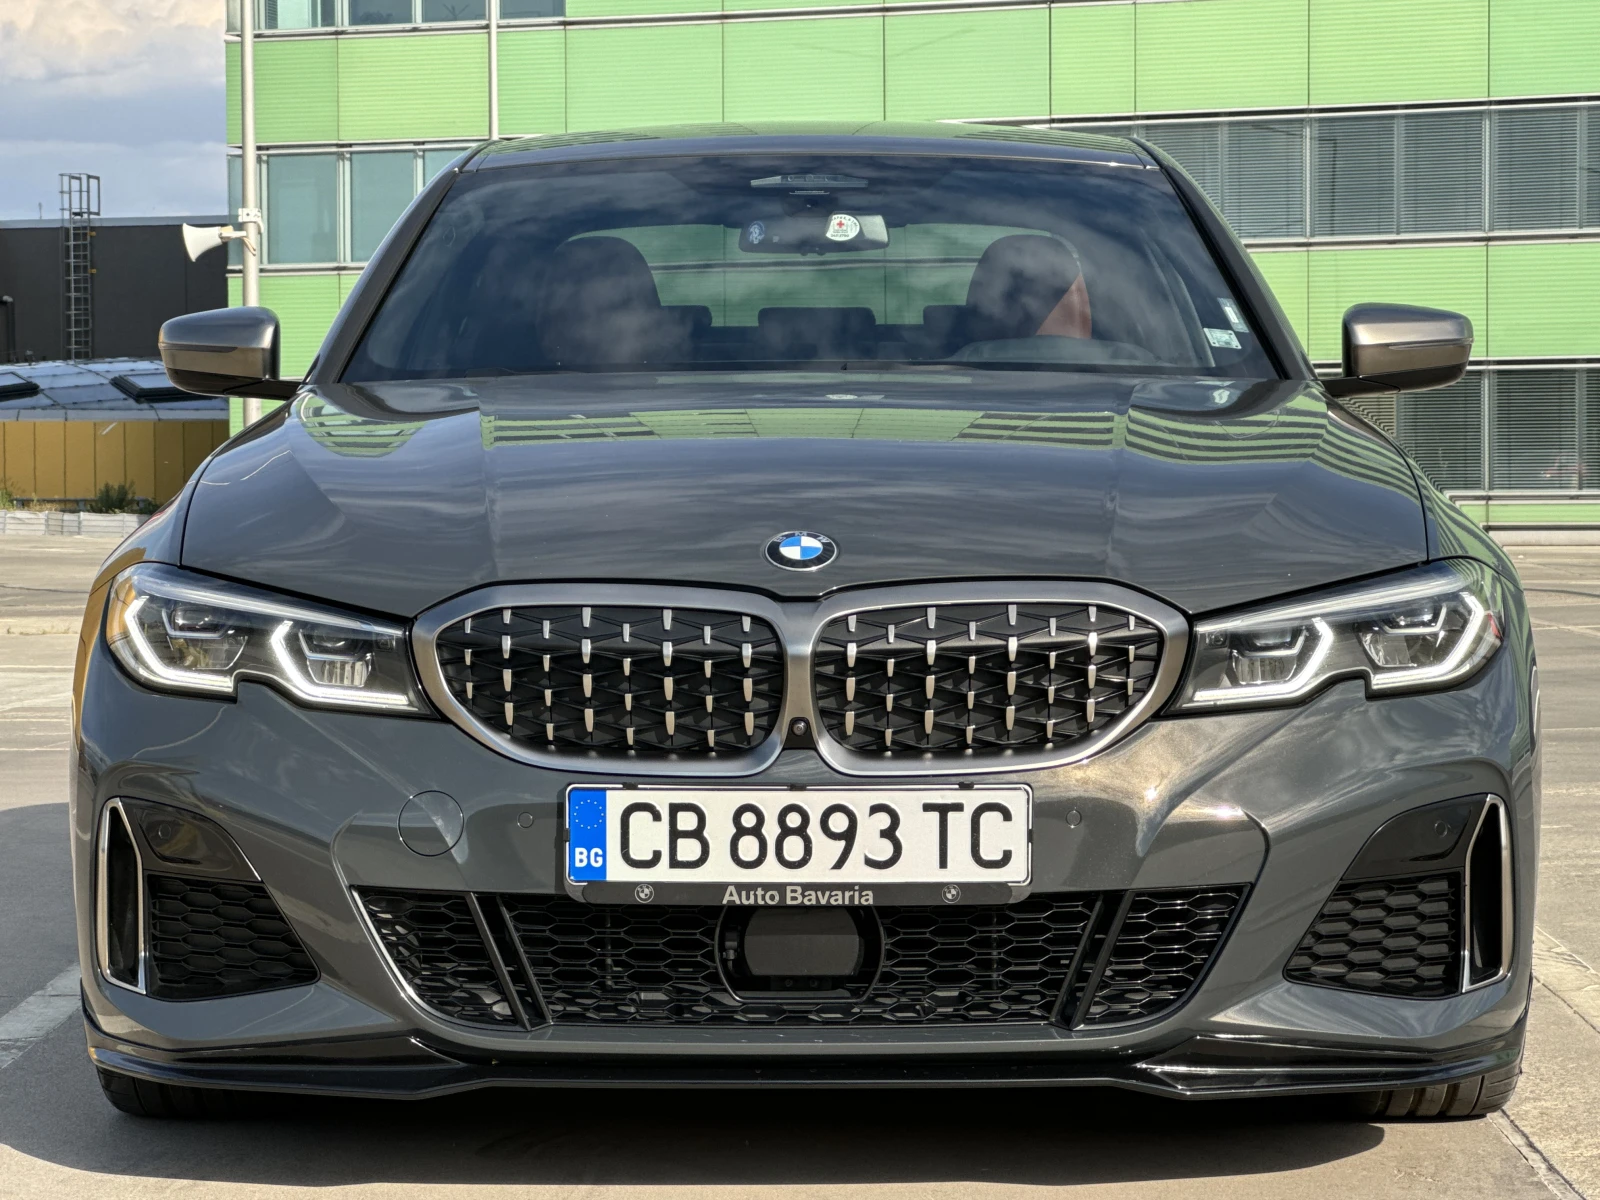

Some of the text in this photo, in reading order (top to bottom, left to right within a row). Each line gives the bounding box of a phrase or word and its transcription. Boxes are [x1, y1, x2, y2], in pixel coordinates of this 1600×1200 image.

[774, 531, 830, 542] BMW
[620, 801, 1013, 870] CB 8893 TC
[574, 847, 603, 867] BG
[722, 885, 874, 905] Auto Bavaria
